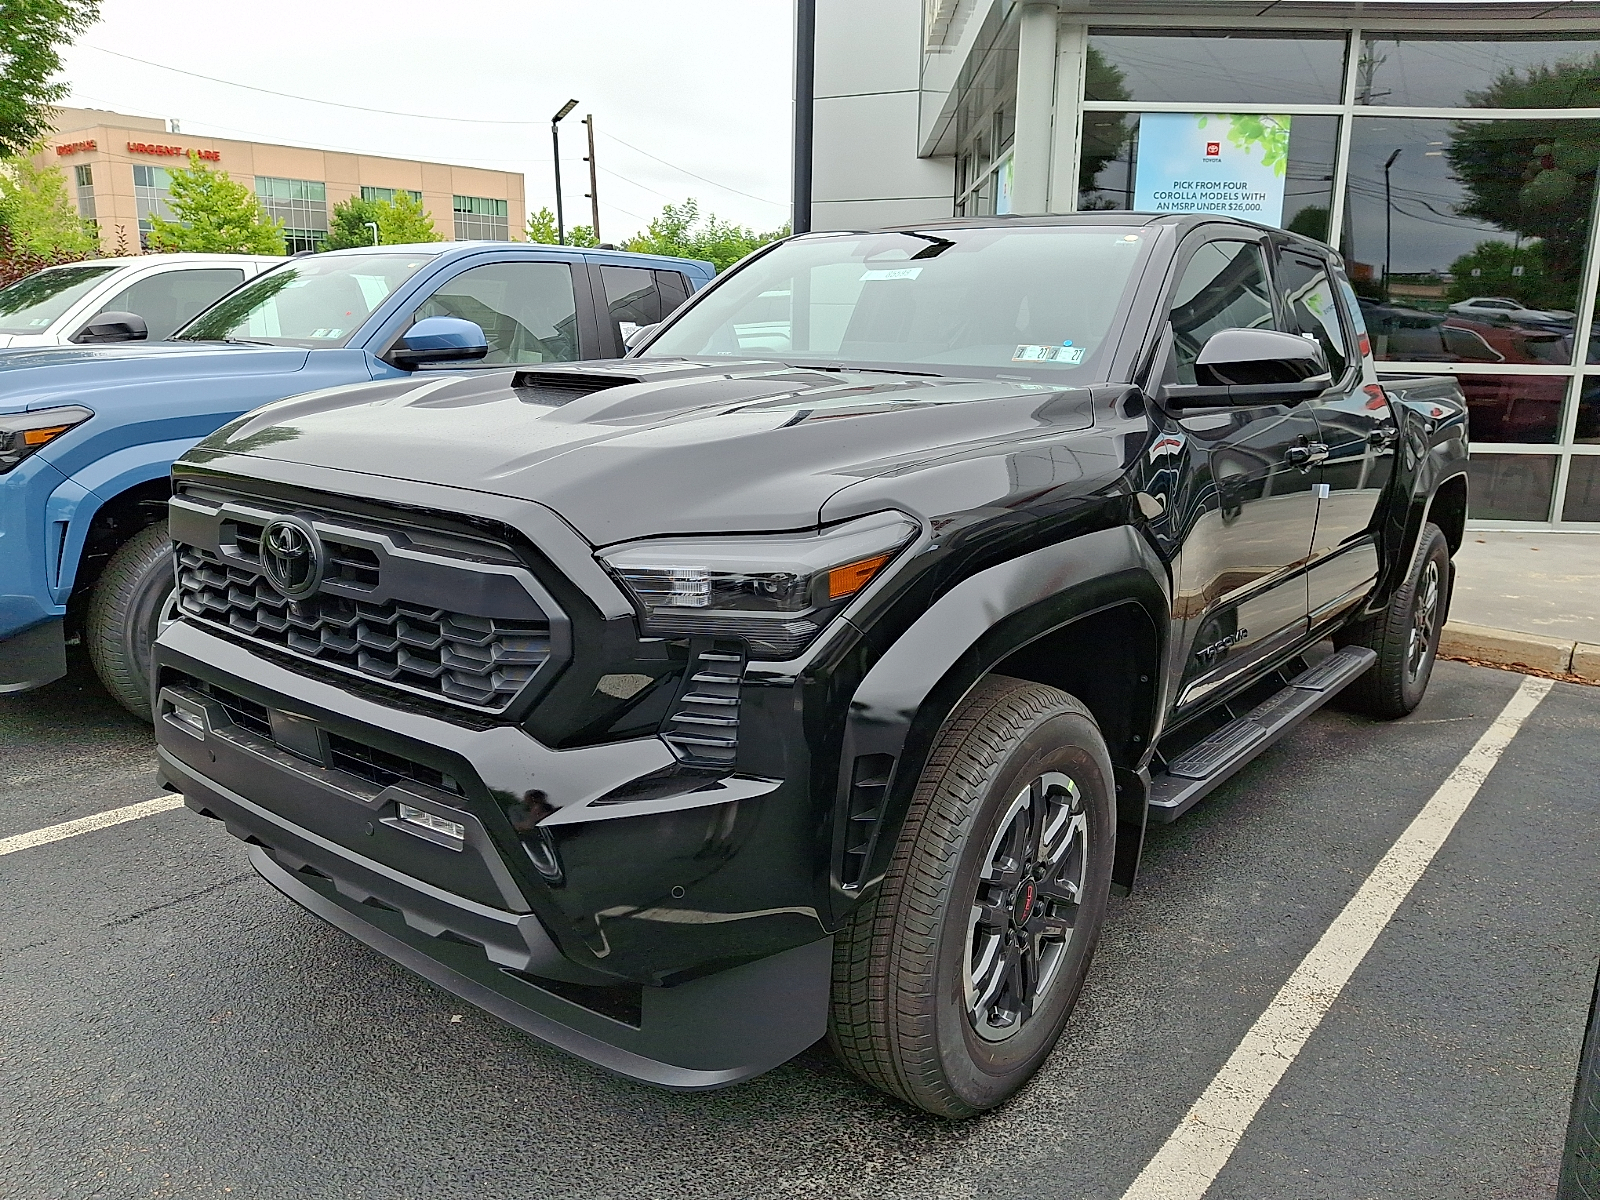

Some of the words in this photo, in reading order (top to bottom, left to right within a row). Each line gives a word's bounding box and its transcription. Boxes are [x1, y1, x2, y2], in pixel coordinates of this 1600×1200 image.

[127, 142, 182, 156] URGENT
[1173, 181, 1193, 190] PICK
[1195, 182, 1221, 190] FROM
[1223, 182, 1247, 190] FOUR
[1153, 191, 1197, 200] COROLLA
[1200, 192, 1239, 201] MODELS
[1241, 193, 1266, 201] WITH
[1157, 202, 1169, 210] AN
[1171, 203, 1195, 211] MSRP
[1196, 203, 1227, 211] UNDER
[1228, 203, 1262, 212] $26,000.
[1071, 349, 1083, 361] 27
